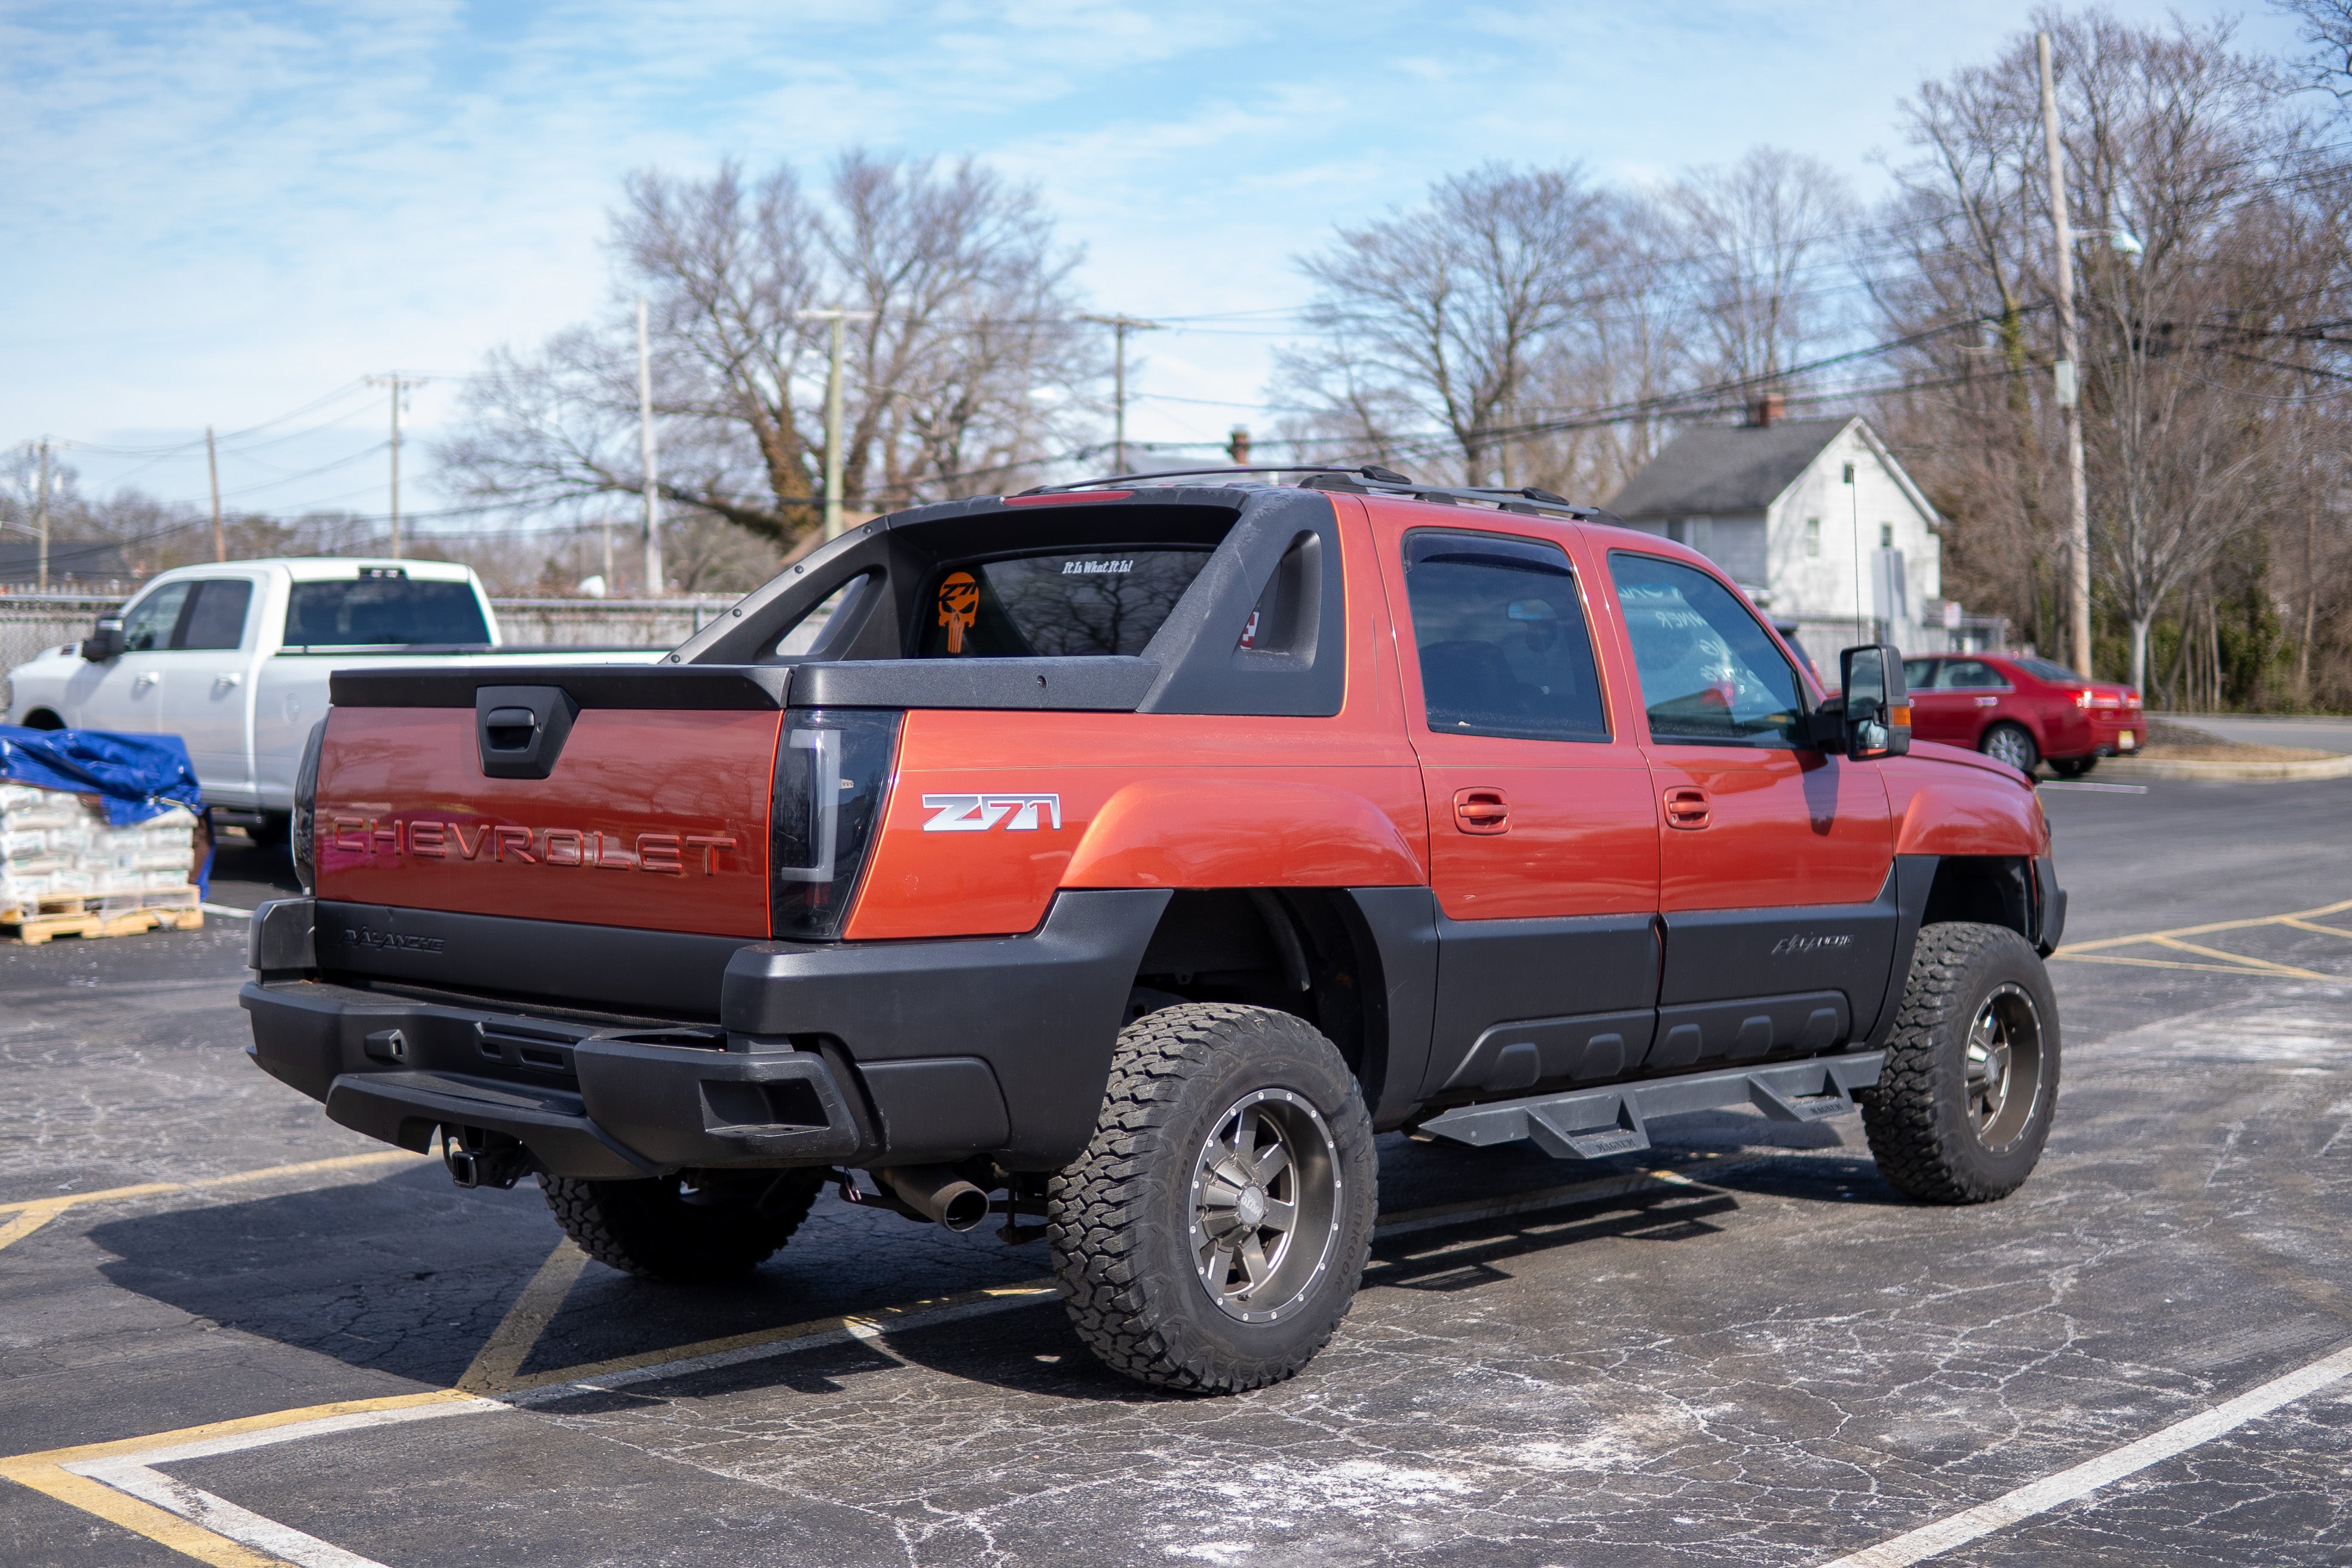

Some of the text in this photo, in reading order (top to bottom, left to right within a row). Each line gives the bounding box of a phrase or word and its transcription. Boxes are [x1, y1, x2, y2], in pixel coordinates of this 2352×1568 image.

[1062, 559, 1134, 574] It Is What It Is!
[922, 793, 1061, 832] Z71
[333, 816, 737, 876] CHEVROLET
[336, 926, 445, 954] AVALANCHE
[1596, 1138, 1636, 1152] MAGNUM
